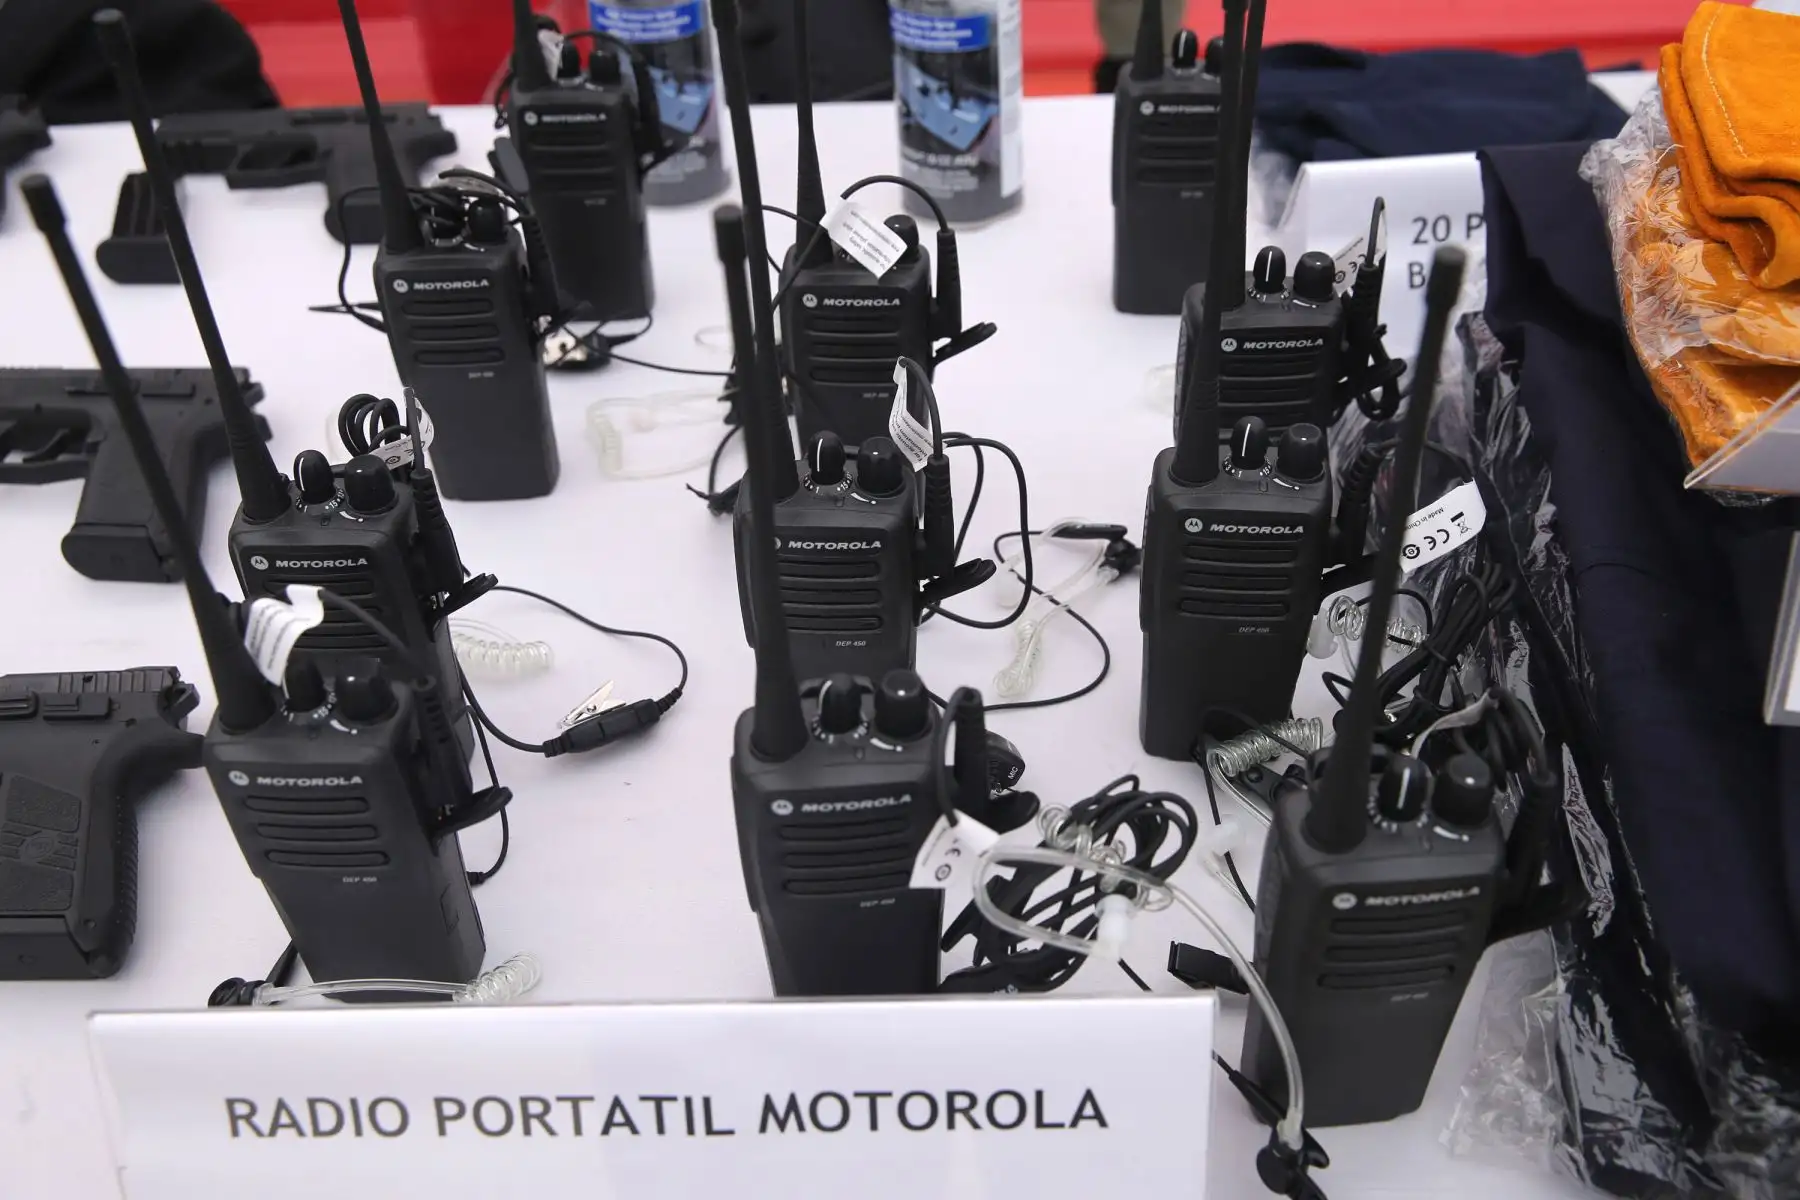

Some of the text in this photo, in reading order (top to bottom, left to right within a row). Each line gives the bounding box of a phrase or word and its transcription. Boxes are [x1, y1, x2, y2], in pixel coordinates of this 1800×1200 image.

[1411, 214, 1451, 245] 20
[413, 279, 489, 290] MOTOROLA
[823, 298, 900, 307] MOTOROLA
[1243, 338, 1324, 349] MOTOROLA
[329, 500, 338, 509] 15
[1210, 523, 1304, 534] MOTOROLA
[788, 540, 882, 550] MOTOROLA
[276, 557, 368, 568] MOTOROLA
[257, 776, 363, 786] MOTOROLA
[801, 793, 912, 813] MOTOROLA
[1365, 886, 1480, 906] MOTOROLA
[226, 1088, 1108, 1137] RADIO PORTATIL MOTOROLA
